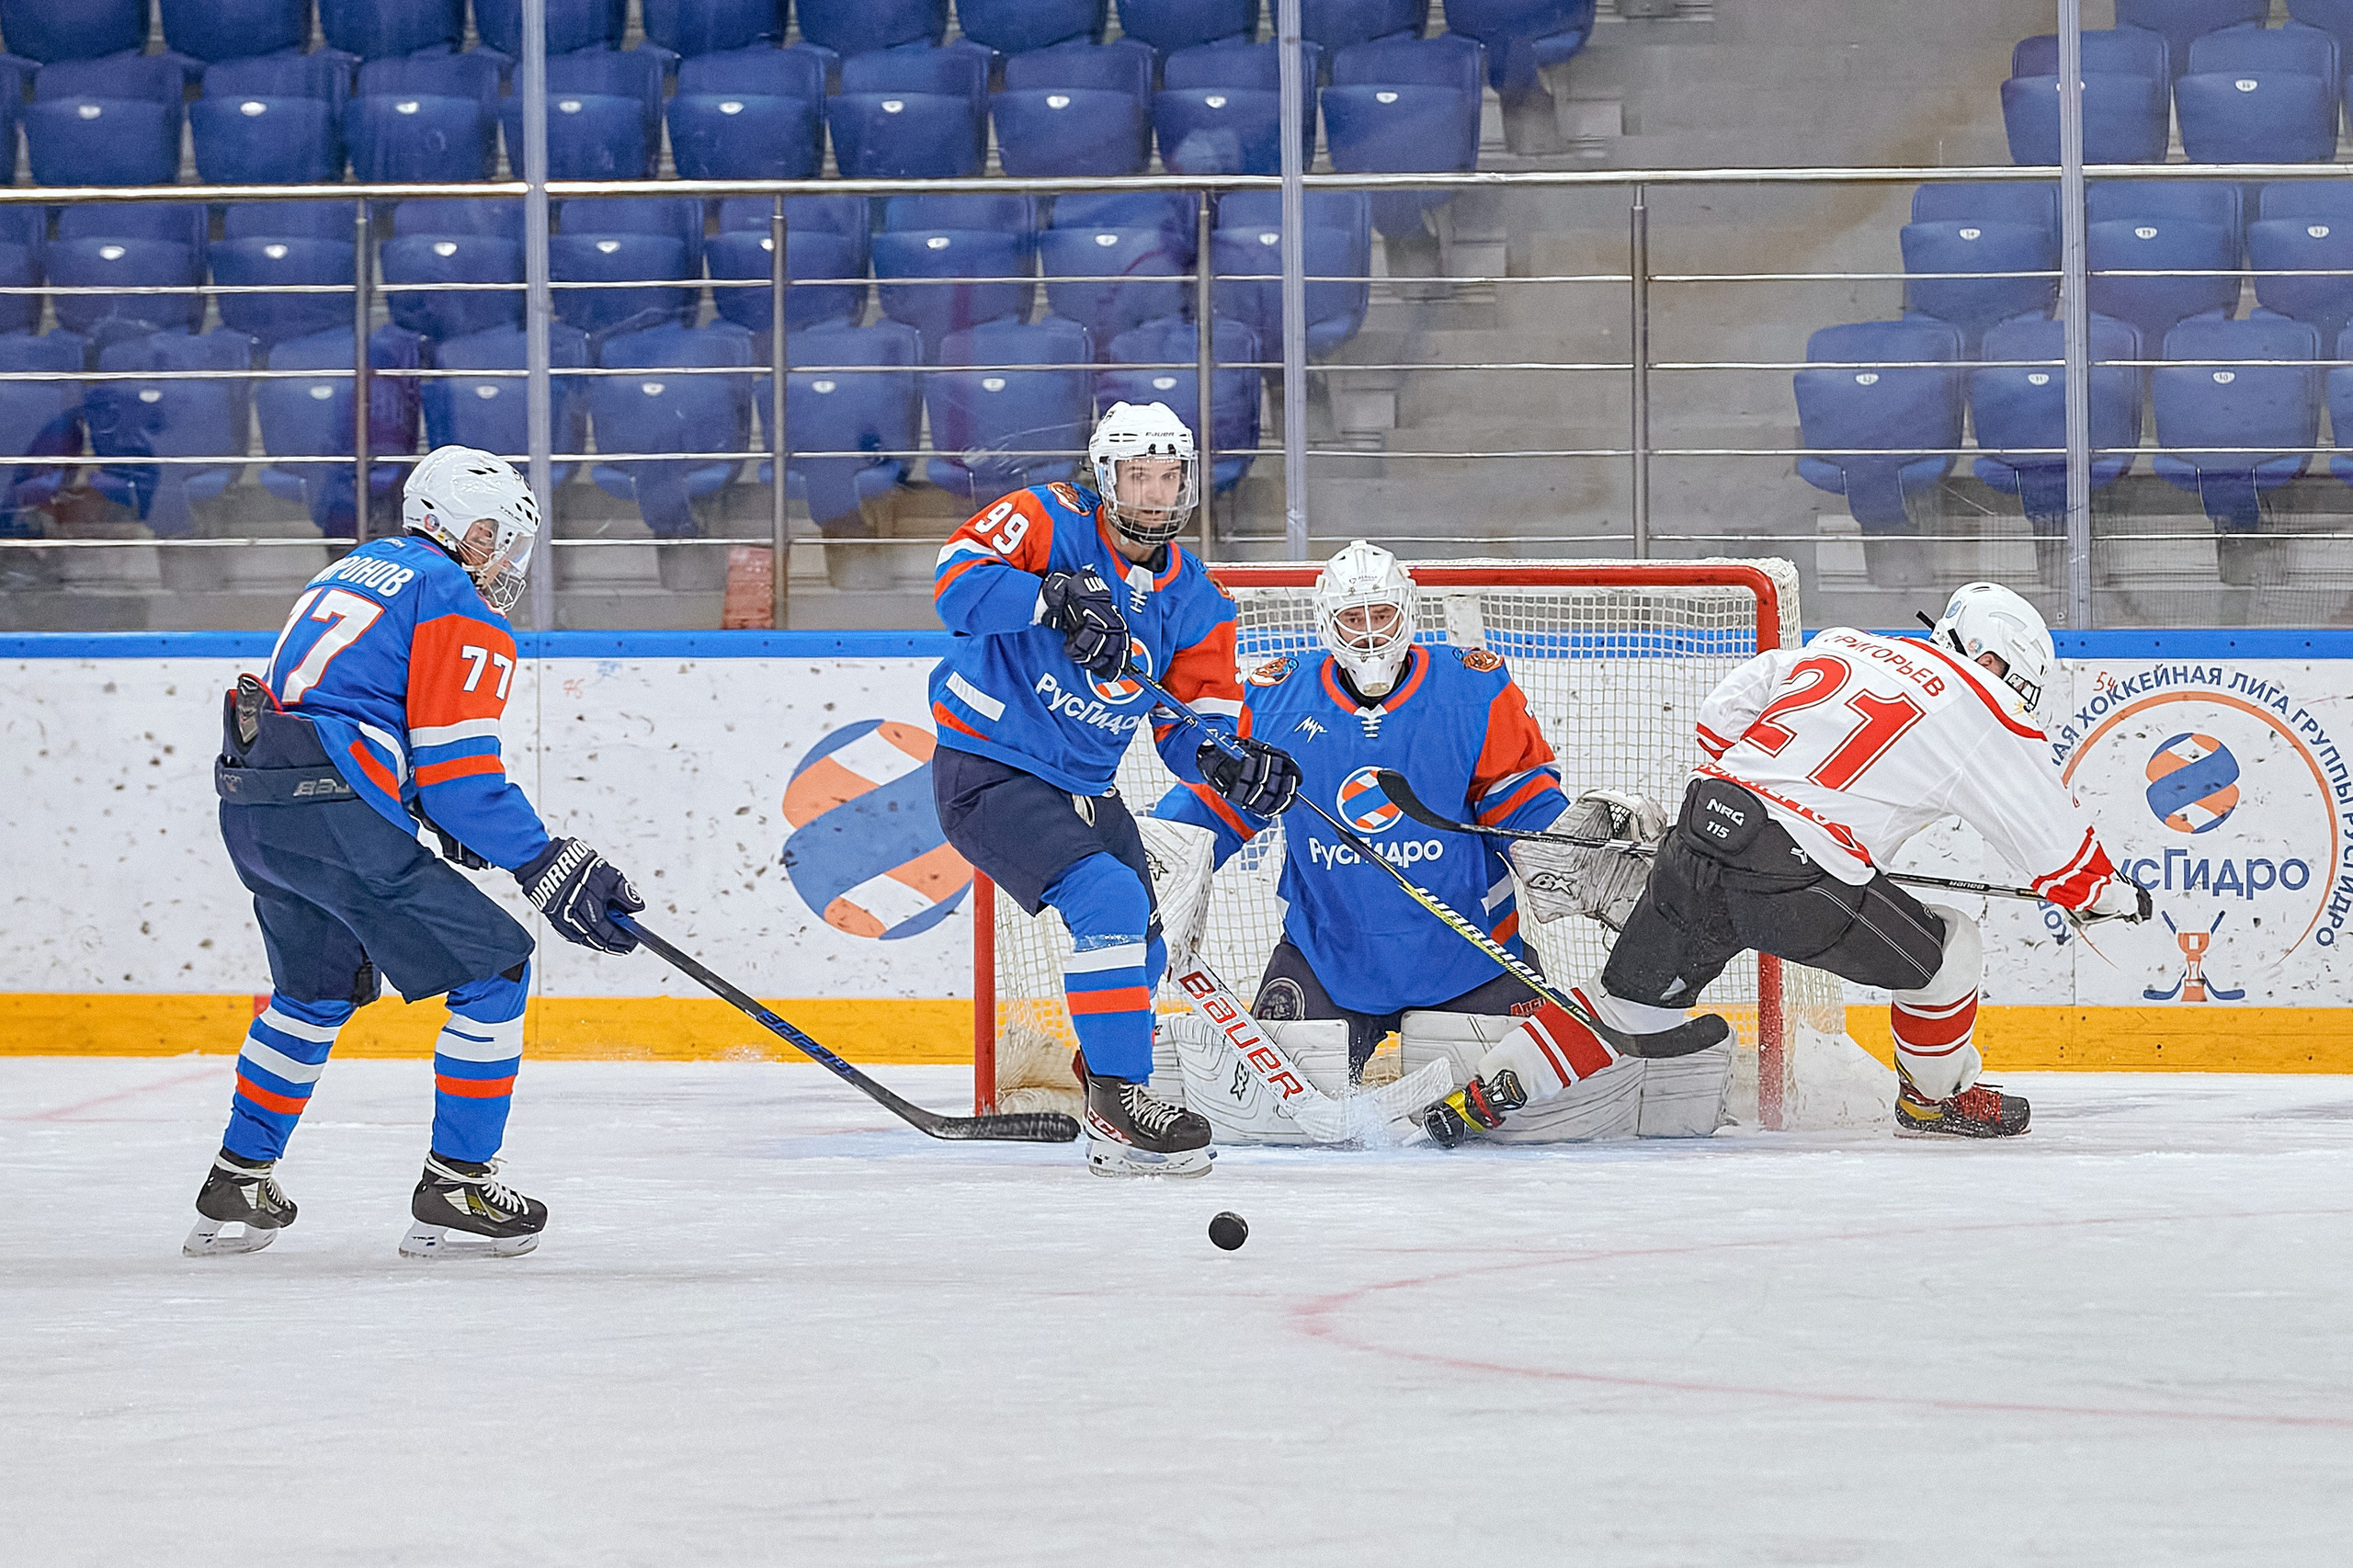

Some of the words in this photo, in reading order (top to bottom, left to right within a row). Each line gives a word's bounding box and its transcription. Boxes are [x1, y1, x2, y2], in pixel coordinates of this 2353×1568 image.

[974, 501, 1030, 555] 99
[267, 586, 386, 706] 77
[460, 644, 514, 700] 77
[1035, 672, 1141, 735] РусГидр
[2093, 671, 2116, 692] 54
[1740, 653, 1927, 792] 21
[2075, 663, 2222, 730] ХОККЕЙНАЯ
[2228, 672, 2290, 715] ЛИГА
[2290, 708, 2353, 805] ГРУППЫ
[1705, 820, 1730, 839] 115
[1706, 798, 1745, 827] NRG
[529, 838, 592, 912] WARRIO
[2119, 848, 2311, 901] сГидро
[1414, 887, 1554, 990] WARRIOR
[1177, 971, 1305, 1101] BAUER
